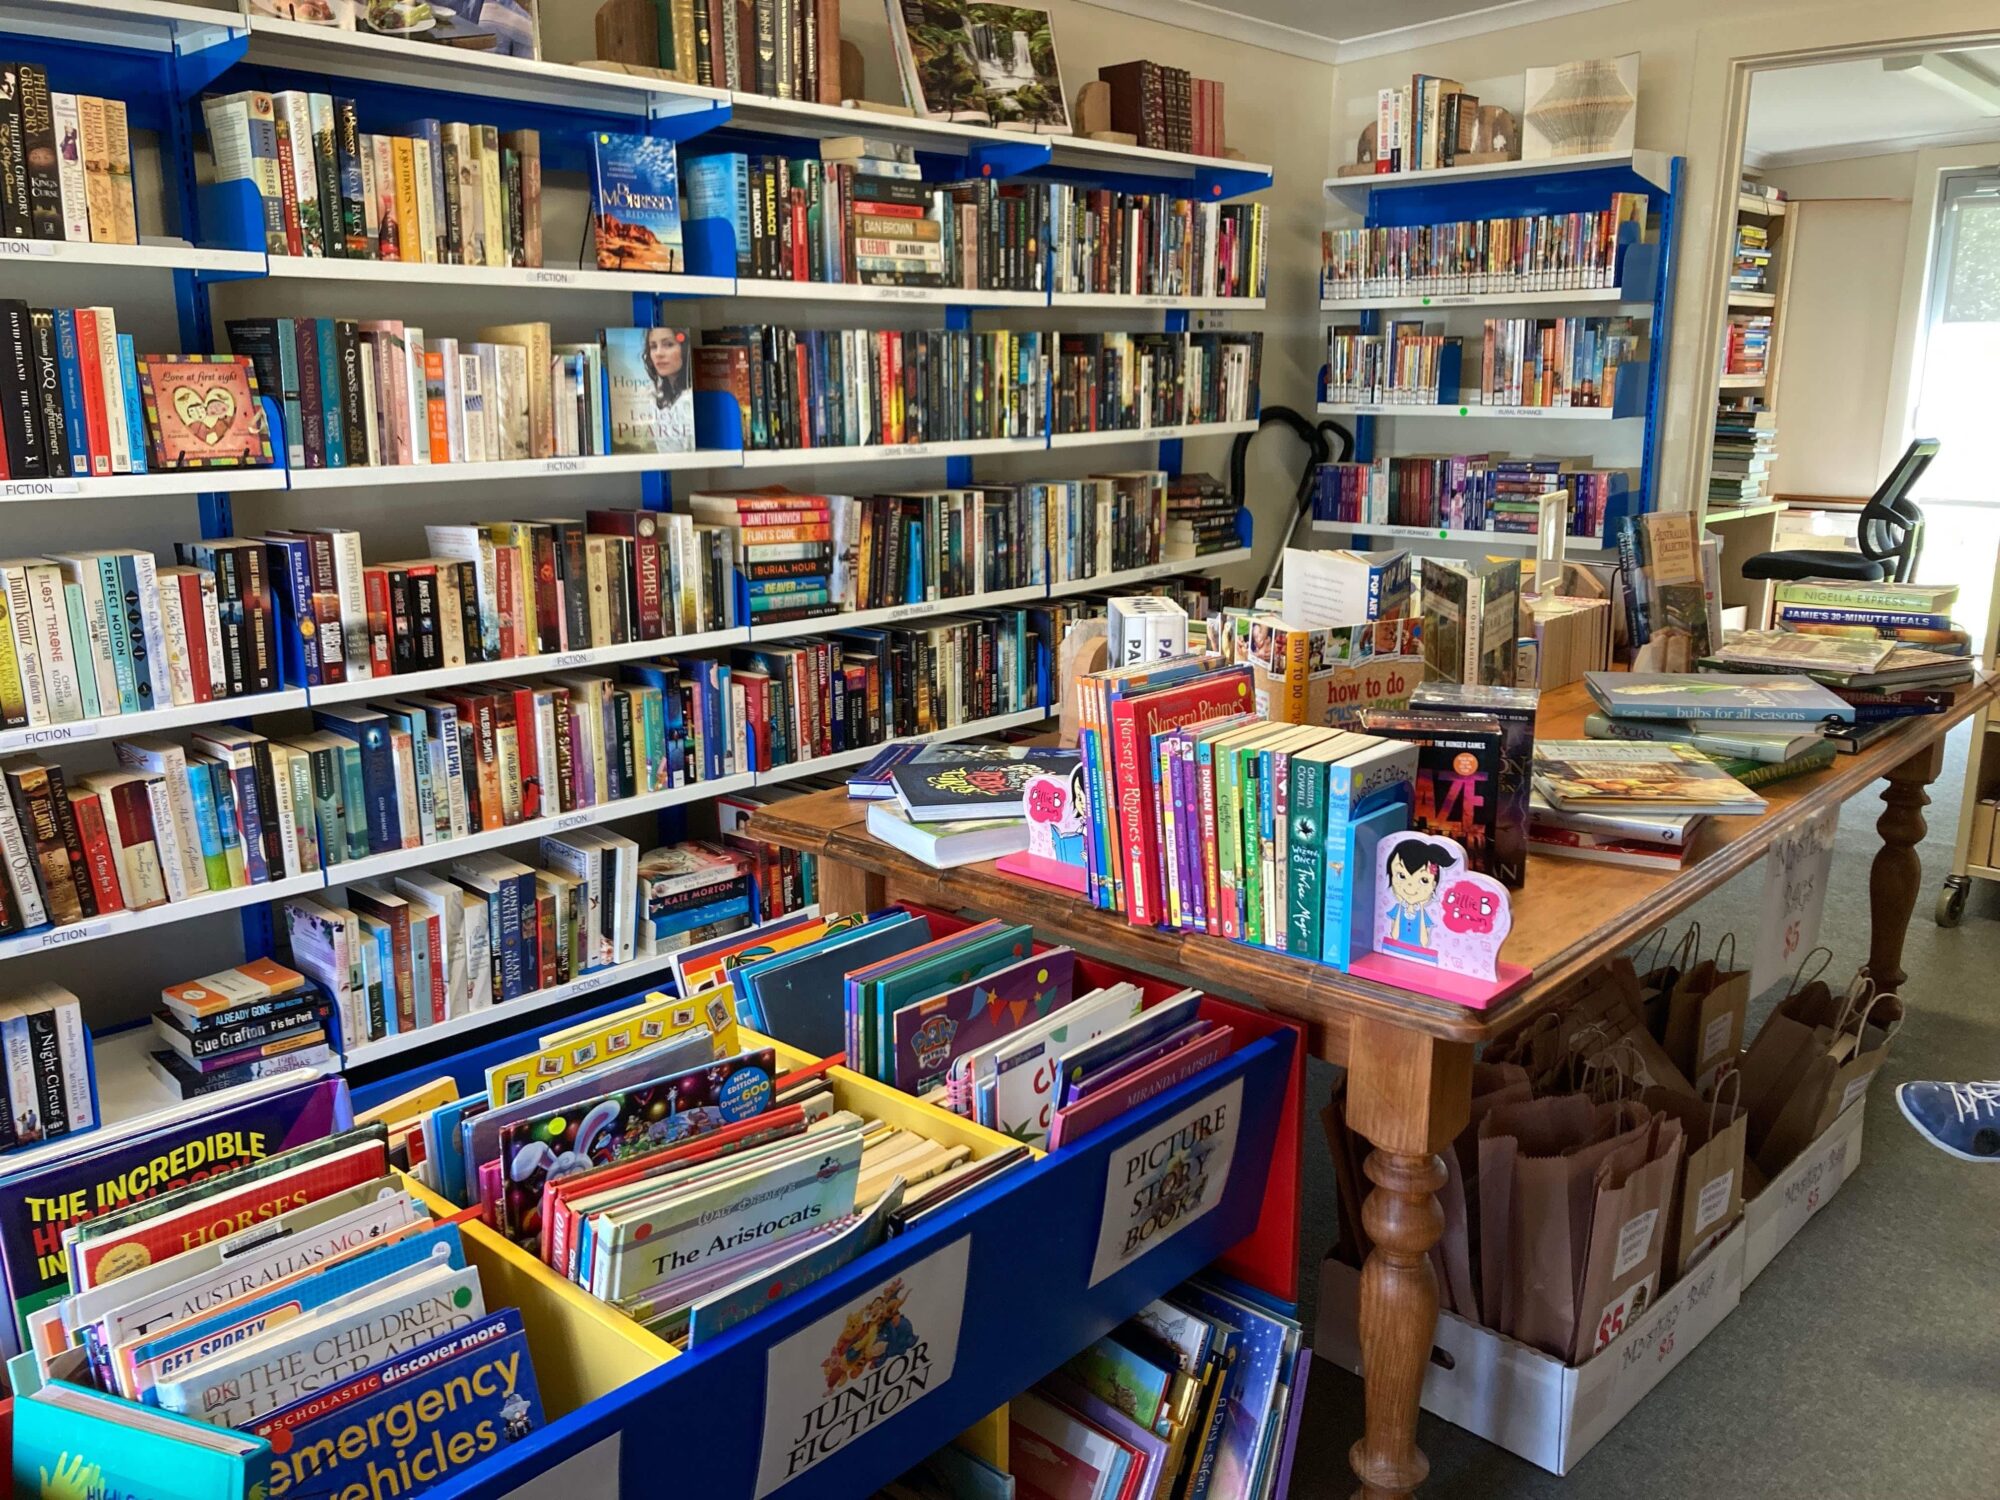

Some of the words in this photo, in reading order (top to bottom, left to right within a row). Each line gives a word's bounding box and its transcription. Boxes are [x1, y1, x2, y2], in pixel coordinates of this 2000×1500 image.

[20, 66, 39, 137] GREGORY
[33, 73, 50, 134] PHILIPPA
[9, 112, 22, 164] PHILIPPA
[264, 158, 276, 197] SISTERS
[737, 159, 746, 176] THE
[15, 166, 28, 217] GREGORY
[602, 187, 675, 211] MORRISSEY
[766, 178, 776, 236] BALDACCI
[351, 204, 364, 236] BACK
[753, 188, 763, 239] BALDACCI
[863, 219, 883, 233] DAN
[885, 219, 914, 234] BROWN
[536, 273, 568, 283] FICTION
[10, 311, 22, 339] DAVID
[14, 342, 27, 381] IRELAND
[880, 334, 889, 377] HARLAN
[39, 355, 56, 390] JACQ
[161, 371, 185, 382] Love
[186, 373, 195, 381] at
[217, 371, 238, 383] sight
[613, 375, 650, 388] Hope
[20, 388, 29, 408] THE
[22, 409, 35, 446] CHOSEN
[44, 393, 60, 456] enlightenment
[617, 422, 692, 440] PEARSE
[630, 410, 674, 424] Lesley
[546, 461, 577, 471] FICTION
[5, 483, 54, 495] FICTION
[746, 513, 765, 525] JANET
[766, 511, 801, 525] EVANOVICH
[747, 528, 774, 541] FLINT'S
[777, 527, 796, 540] CODE
[294, 551, 305, 584] BEDLAM
[344, 537, 357, 587] MATTHEW
[641, 544, 658, 606] EMPIRE
[757, 563, 790, 576] BURIAL
[792, 561, 817, 573] HOUR
[7, 571, 26, 607] Judith
[40, 580, 55, 611] LOST
[297, 585, 307, 613] STACKS
[350, 588, 361, 614] REILLY
[418, 580, 431, 598] ANNE
[1370, 574, 1380, 596] POP
[1804, 591, 1853, 602] NIGELLA
[1856, 594, 1907, 607] EXPRESS
[104, 561, 118, 609] PERFECT
[112, 614, 126, 657] MOTION
[419, 598, 431, 615] RICE
[909, 604, 933, 616] THRILLER
[1368, 599, 1378, 620] ART
[1786, 610, 1829, 621] JAMIE'S
[1830, 612, 1890, 624] 30-MINUTE
[1891, 615, 1930, 626] MEALS
[16, 609, 33, 647] Krantz
[46, 614, 63, 663] THRONE
[95, 599, 106, 630] STEPHEN
[101, 630, 111, 661] LEATHER
[319, 622, 342, 663] SCARECROW
[557, 653, 587, 665] FICTION
[1294, 639, 1304, 664] HOW
[1294, 666, 1304, 681] TO
[1328, 679, 1361, 703] how
[1365, 678, 1382, 697] to
[1386, 671, 1405, 693] do
[1294, 684, 1304, 698] DO
[479, 707, 491, 737] WILBUR
[1676, 707, 1713, 719] bulbs
[1714, 707, 1731, 719] for
[1733, 707, 1752, 719] all
[1753, 709, 1806, 721] seasons
[25, 727, 72, 744] FICTION
[444, 720, 457, 743] EXIT
[1116, 717, 1134, 771] Nursery
[1434, 739, 1444, 747] THE
[1465, 742, 1486, 750] GAMES
[1605, 723, 1655, 740] ACACIAS
[447, 745, 460, 778] ALPHA
[482, 738, 494, 763] SMITH
[507, 750, 519, 779] WILBUR
[293, 764, 305, 801] MANNING
[300, 769, 310, 796] KIRSTY
[510, 781, 520, 805] SMITH
[1202, 768, 1212, 811] DUNCAN
[1297, 765, 1307, 808] COWELL
[1306, 766, 1316, 809] CRESSIDA
[243, 783, 258, 816] MEMORY
[1122, 786, 1142, 843] Rhymes
[31, 799, 54, 840] ATLANTIS
[559, 814, 587, 827] FICTION
[1204, 813, 1214, 838] BALL
[51, 776, 65, 798] IAN
[73, 865, 90, 900] SOLAR
[246, 822, 260, 858] RUNNING
[501, 885, 512, 934] WALTERS
[508, 884, 519, 932] MINETTE
[664, 891, 689, 906] KATE
[690, 881, 734, 899] MORTON
[42, 928, 87, 946] FICTION
[504, 950, 515, 988] HOURS
[511, 957, 520, 981] LAST
[571, 978, 600, 993] FICTION
[215, 1009, 250, 1026] ALREADY
[251, 1002, 273, 1017] GONE
[195, 1036, 218, 1055] Sue
[220, 1023, 266, 1048] Grafton
[271, 1019, 278, 1031] P
[278, 1018, 285, 1030] is
[286, 1015, 295, 1028] for
[296, 1010, 313, 1026] Peril
[910, 1015, 958, 1051] PAW
[9, 1036, 20, 1072] MORGAN
[19, 1037, 31, 1067] SARAH
[41, 1033, 56, 1072] Night
[206, 1070, 239, 1084] JAMES
[727, 1075, 760, 1096] EDITION!
[733, 1072, 751, 1083] NEW
[1126, 1074, 1178, 1109] MIRANDA
[1179, 1051, 1219, 1079] TAPSELL
[45, 1072, 61, 1117] Circus
[721, 1096, 740, 1109] Over
[742, 1080, 769, 1102] 600
[1124, 1104, 1228, 1188] PICTURE
[25, 1188, 87, 1222] THE
[96, 1131, 267, 1208] INCREDIBLE
[1130, 1150, 1212, 1220] STORY
[181, 1188, 309, 1251] HORSES
[652, 1249, 701, 1276] The
[706, 1200, 822, 1258] Aristocats
[273, 1377, 379, 1431] SCHOLASTIC
[381, 1342, 456, 1384] discover
[460, 1318, 507, 1350] more
[794, 1341, 933, 1445] JUNIOR
[269, 1350, 522, 1498] emergency
[783, 1362, 935, 1481] FICTION
